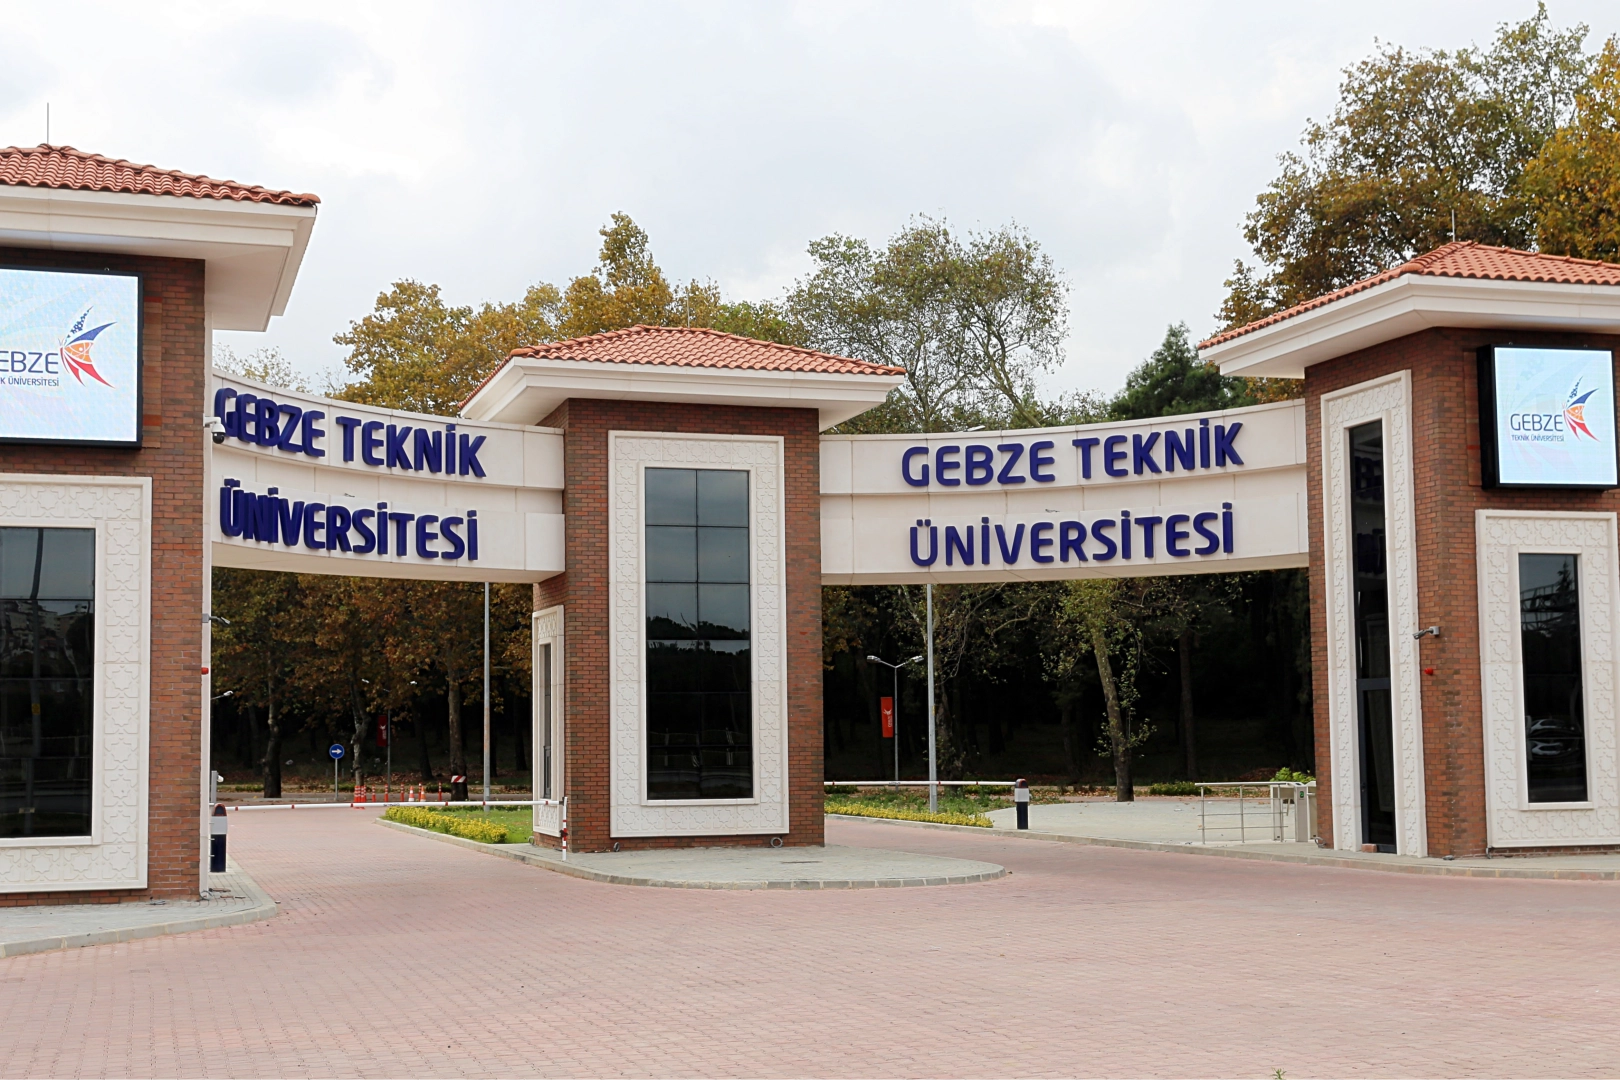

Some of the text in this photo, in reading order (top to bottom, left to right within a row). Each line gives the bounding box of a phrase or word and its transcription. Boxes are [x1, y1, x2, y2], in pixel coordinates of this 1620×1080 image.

[8, 375, 59, 386] ÜNİVERSİTESİ
[215, 387, 487, 478] GEBZE TEKNİK
[902, 418, 1244, 487] GEBZE TEKNİK
[1510, 413, 1563, 432] GEBZE
[220, 478, 479, 561] ÜNİVERSİTESİ
[910, 502, 1234, 566] ÜNİVERSİTESİ
